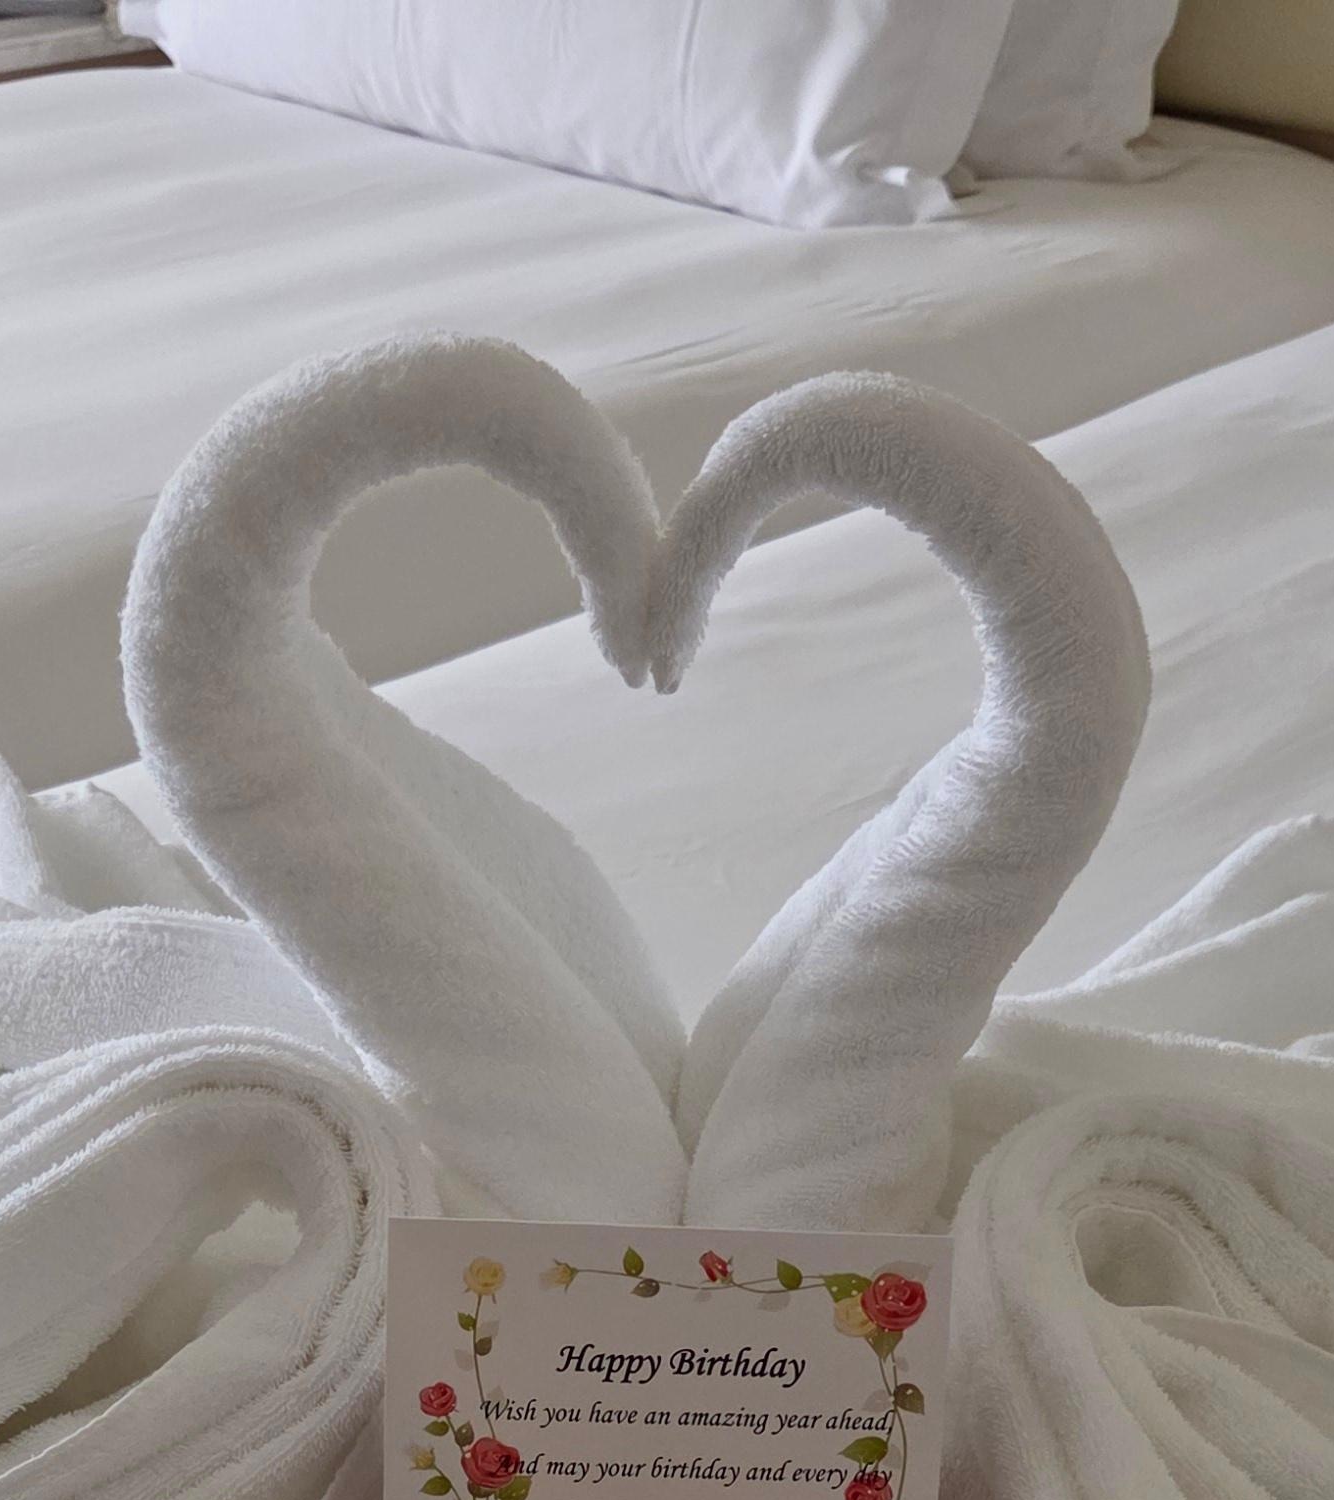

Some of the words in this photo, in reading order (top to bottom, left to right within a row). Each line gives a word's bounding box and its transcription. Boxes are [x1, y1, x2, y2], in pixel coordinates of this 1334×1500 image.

[556, 1343, 662, 1385] Happy
[669, 1346, 807, 1388] Birthday
[480, 1398, 537, 1421] Wish
[539, 1407, 582, 1429] you
[588, 1400, 639, 1425] have
[643, 1409, 671, 1426] an
[677, 1407, 770, 1436] amazing
[770, 1413, 823, 1436] year
[825, 1408, 896, 1435] ahead,
[493, 1453, 546, 1476] And
[546, 1462, 590, 1483] may
[592, 1463, 647, 1484] your
[650, 1456, 741, 1488] birthday
[745, 1459, 793, 1482] and
[792, 1467, 848, 1490] every
[853, 1461, 893, 1492] day
